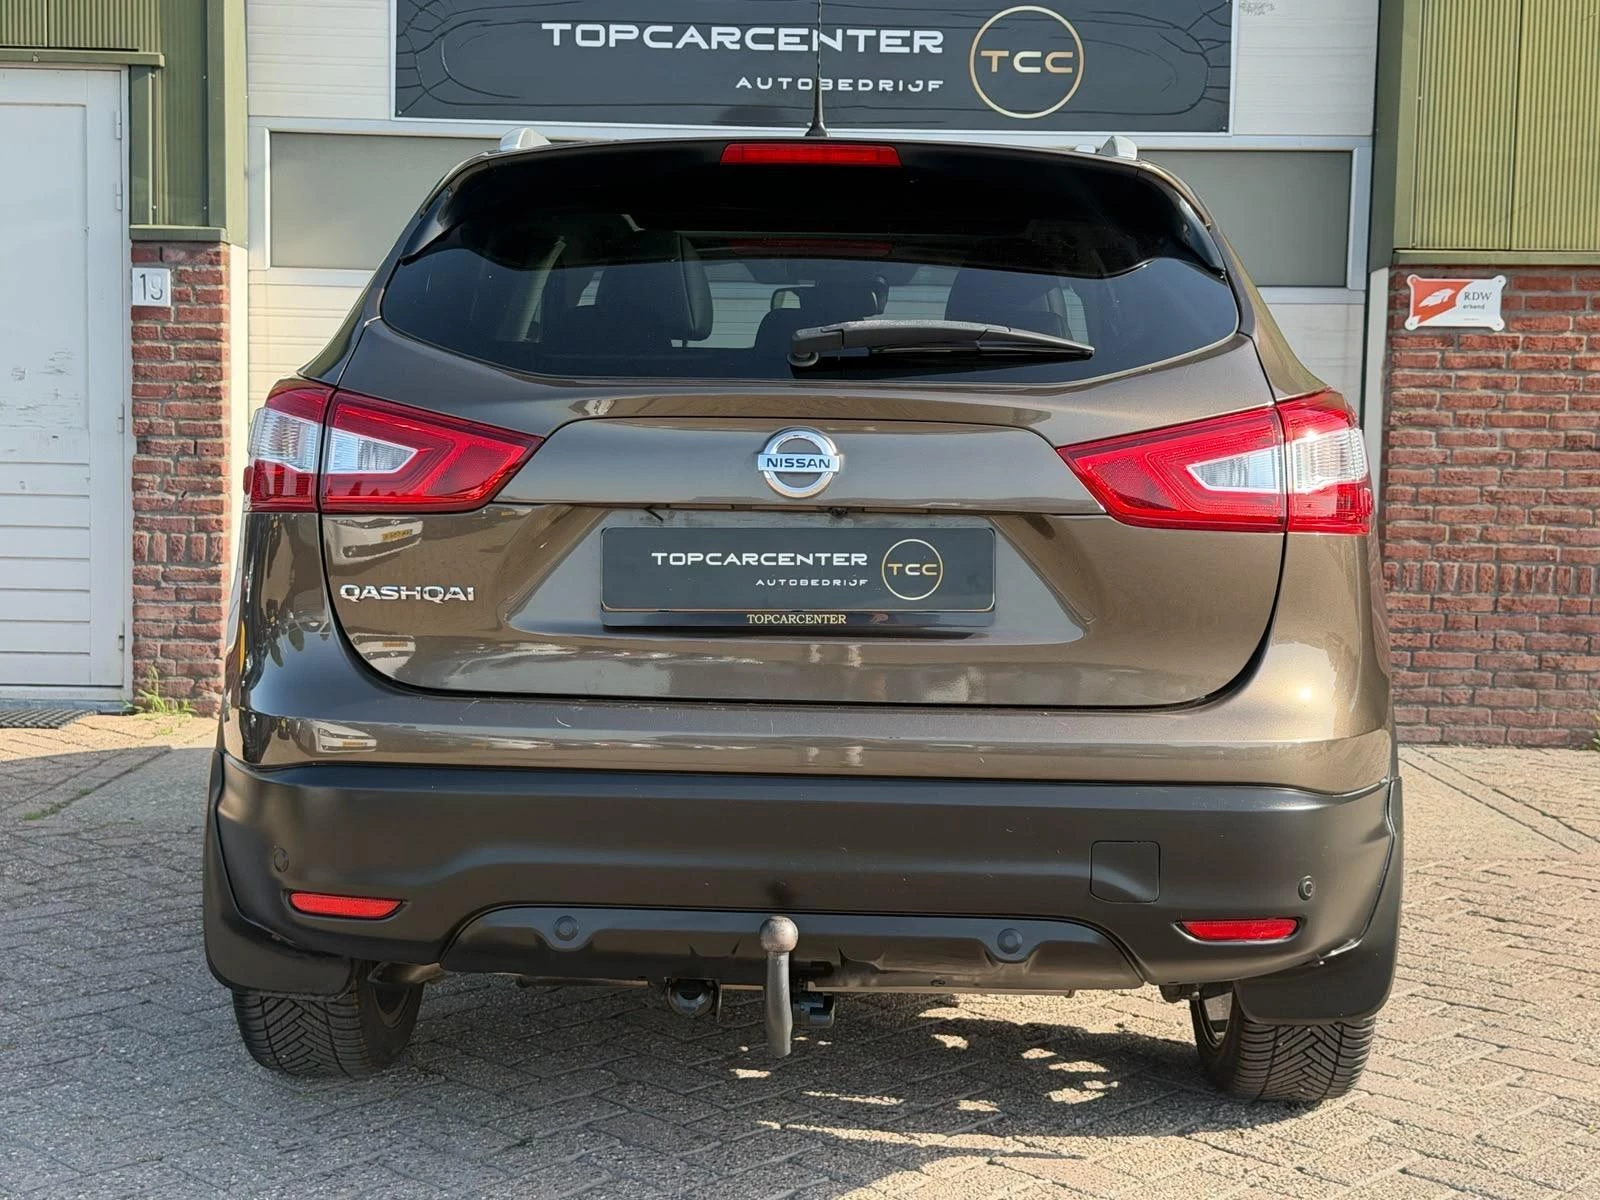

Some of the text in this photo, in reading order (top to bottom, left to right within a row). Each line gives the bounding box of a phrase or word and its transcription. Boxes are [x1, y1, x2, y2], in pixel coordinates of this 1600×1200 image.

[541, 23, 944, 53] TOPCARCENTER
[980, 50, 1074, 73] TCC
[735, 76, 944, 92] AUTOBEDRIJF
[1464, 292, 1492, 301] RDW
[766, 457, 831, 469] NISSAN
[651, 552, 868, 566] TOPCARCENTER
[887, 563, 938, 576] TCC
[755, 578, 869, 587] AUTOBEDRIJF
[339, 584, 475, 604] QASHQAI
[746, 613, 847, 626] TOPCARCENTER
